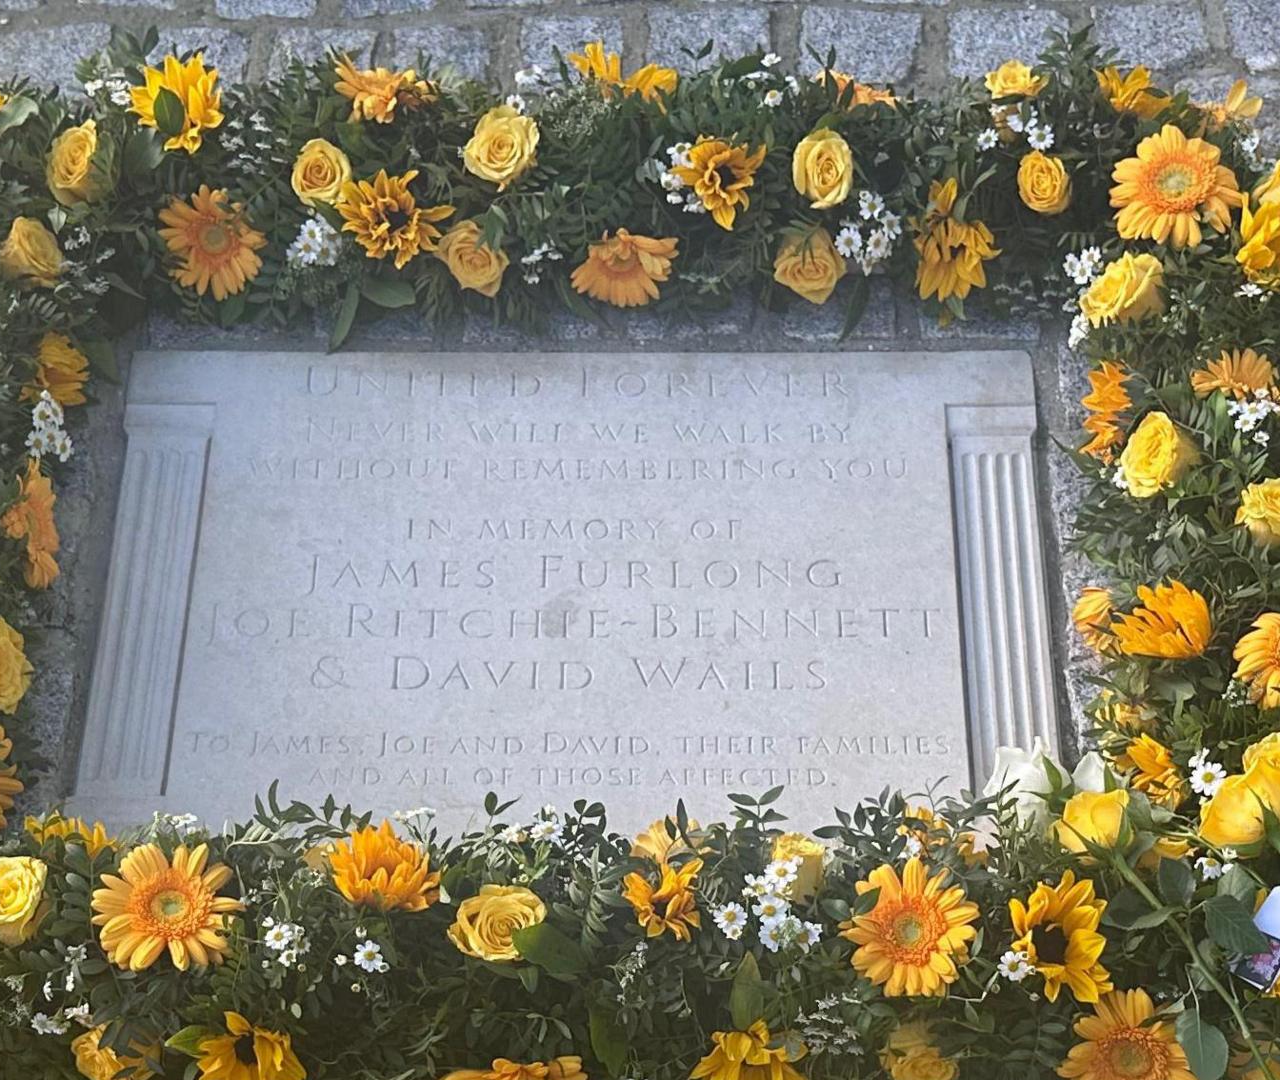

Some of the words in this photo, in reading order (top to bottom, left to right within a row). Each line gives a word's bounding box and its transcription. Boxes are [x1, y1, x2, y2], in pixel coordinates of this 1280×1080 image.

[304, 365, 542, 398] UNITED
[581, 366, 851, 398] FOREVER
[306, 417, 445, 444] NEVER
[469, 422, 564, 444] WILL
[589, 422, 649, 444] WE
[671, 422, 785, 444] WALK
[807, 422, 852, 445] BY
[248, 457, 459, 480] WITHOUT
[482, 457, 797, 480] REMEMBERING
[820, 457, 908, 480] YOU
[407, 518, 453, 541] IN
[478, 518, 665, 541] MEMORY
[690, 518, 743, 541] OF
[304, 554, 497, 597] JAMES
[538, 554, 843, 590] FURLONG
[205, 602, 313, 647] JOE
[310, 655, 352, 690] &
[389, 655, 594, 691] DAVID
[631, 656, 828, 691] WAILS
[248, 731, 366, 758] JAMES,
[378, 731, 436, 757] JOE
[448, 734, 525, 756] AND
[673, 734, 779, 756] THEIR
[797, 734, 952, 756] FAMILIES
[308, 765, 385, 786] AND
[398, 766, 460, 786] ALL
[472, 766, 515, 787] OF
[531, 766, 642, 787] THOSE
[657, 767, 838, 788] AFFECTED.
